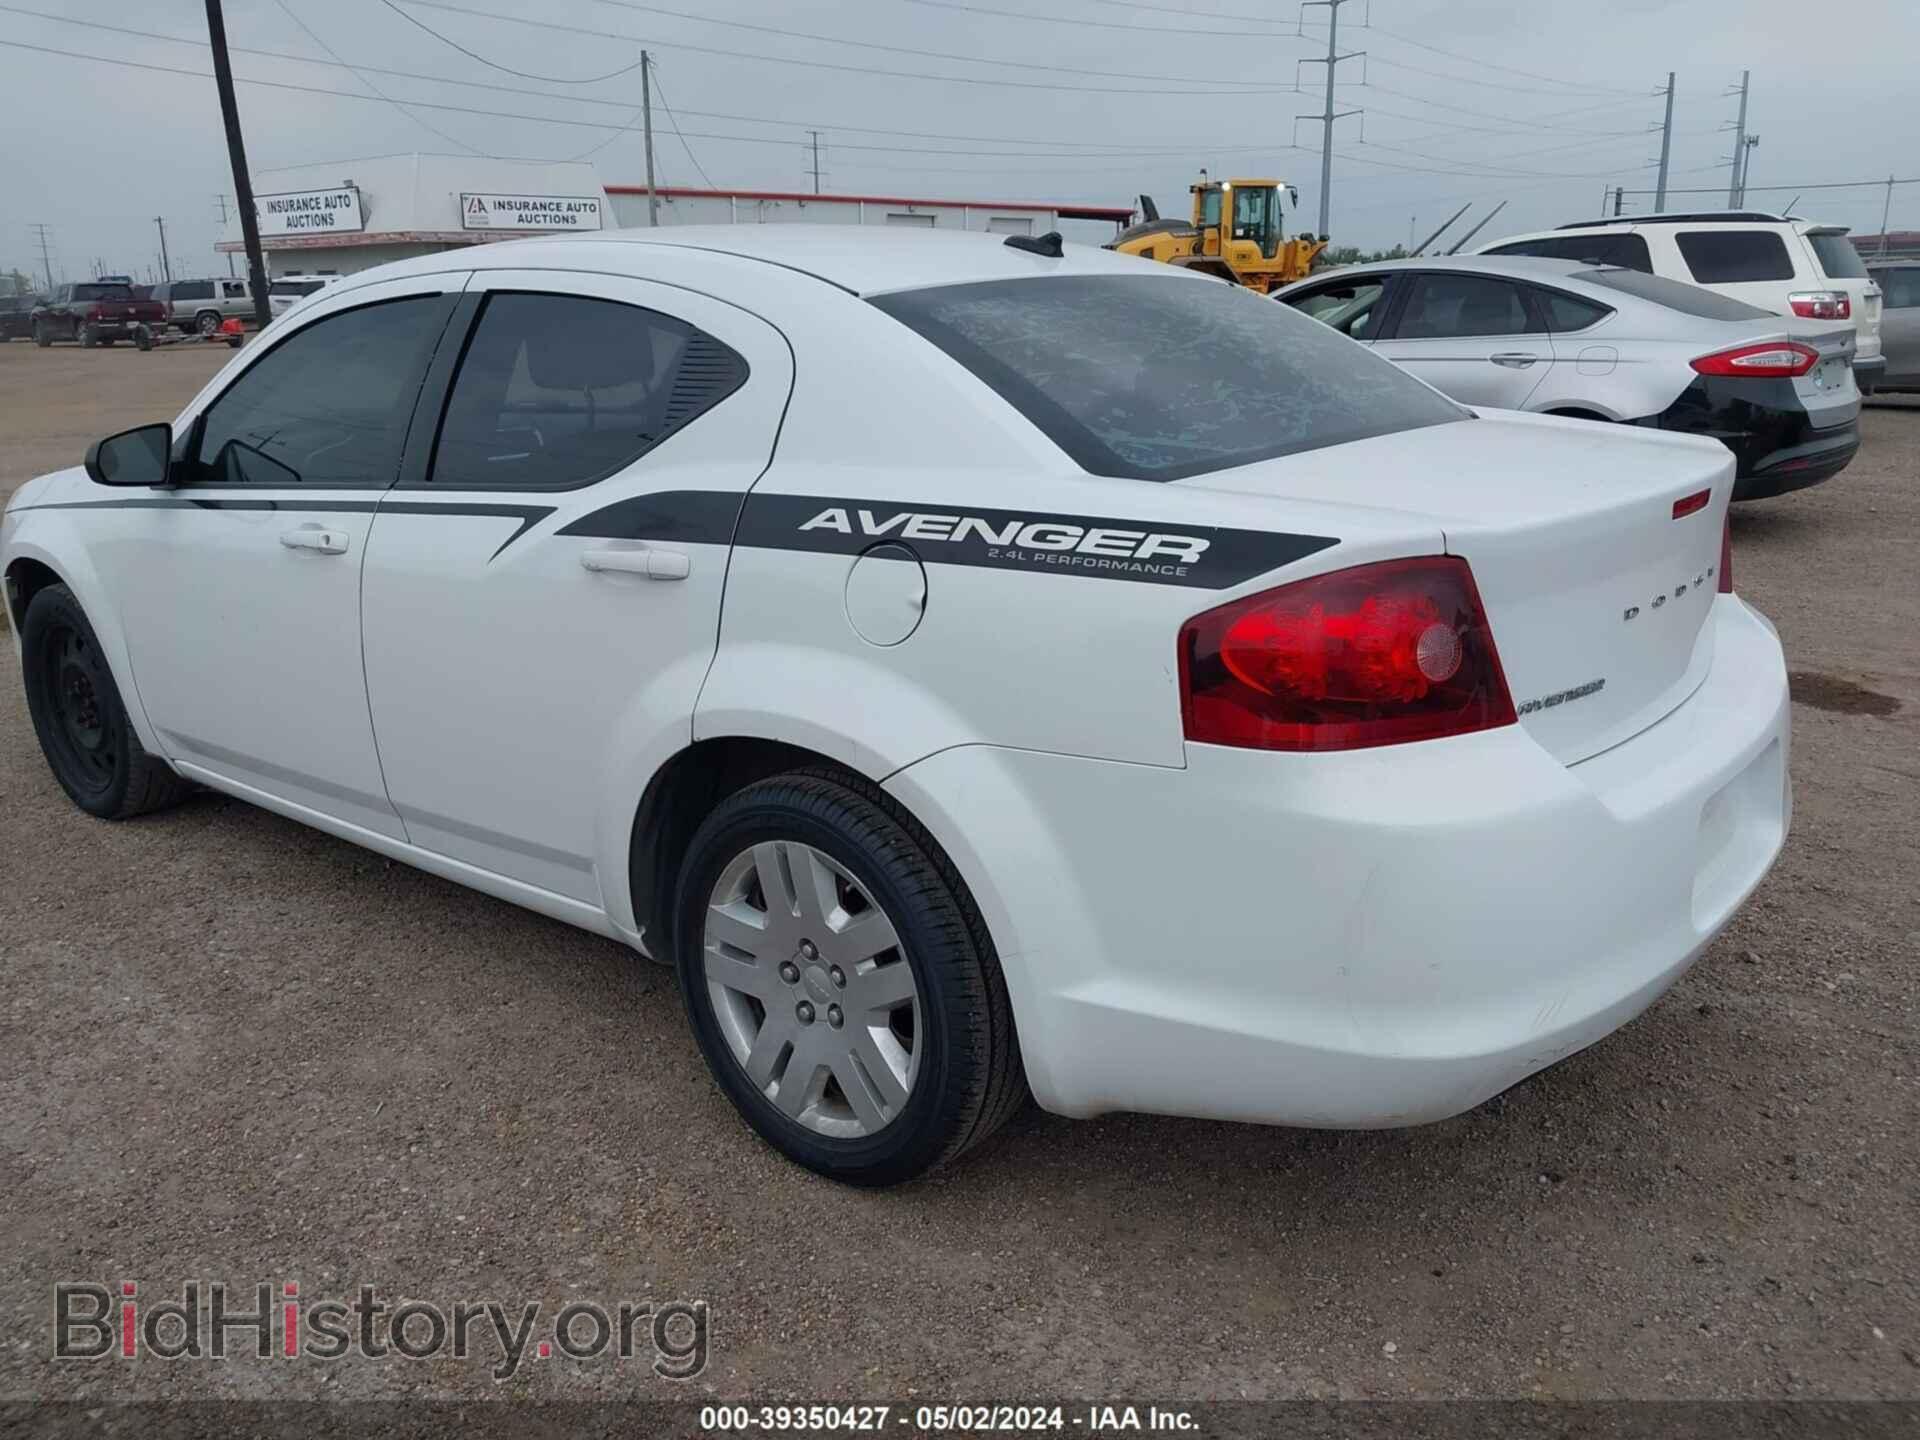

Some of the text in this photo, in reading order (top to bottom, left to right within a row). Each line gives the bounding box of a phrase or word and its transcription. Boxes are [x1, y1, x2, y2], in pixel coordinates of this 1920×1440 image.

[267, 194, 351, 214] INSURANCE AUTO
[494, 200, 597, 214] INSURANCE AUTO
[286, 212, 335, 228] AUCTIONS
[517, 214, 577, 225] AUCTIONS
[797, 507, 1211, 564] AVENGER
[987, 548, 1189, 577] 2.4L PERFORMANCE
